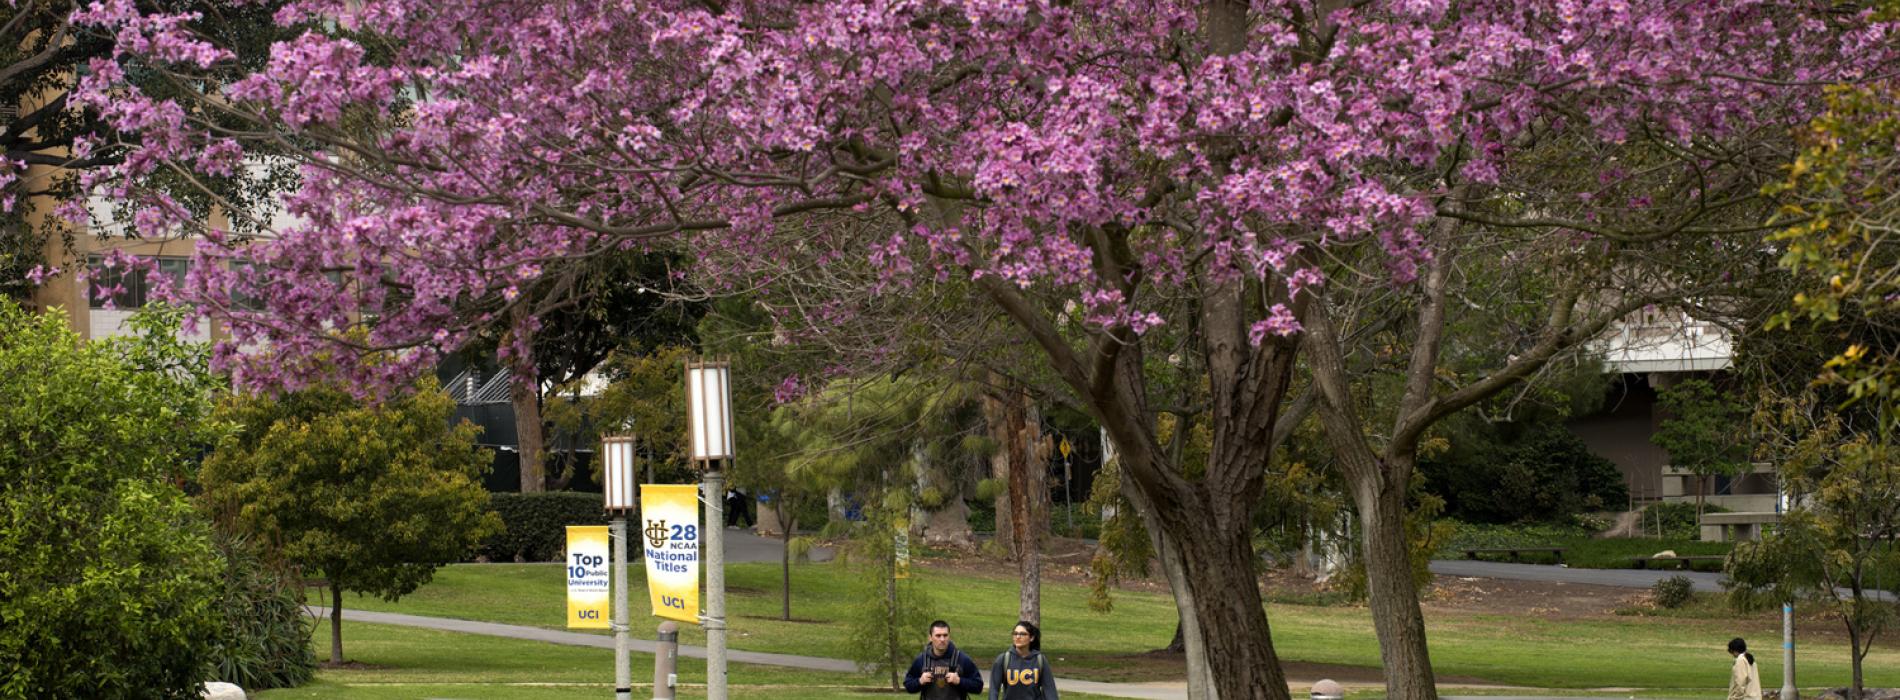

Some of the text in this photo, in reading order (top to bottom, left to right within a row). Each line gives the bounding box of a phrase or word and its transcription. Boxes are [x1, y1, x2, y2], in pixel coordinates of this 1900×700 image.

[670, 524, 697, 541] 28
[670, 542, 697, 550] NCAA
[572, 553, 603, 568] Top
[646, 548, 697, 561] National
[568, 566, 585, 578] 10
[655, 560, 688, 573] Titles
[568, 579, 608, 587] University
[662, 594, 685, 609] UCI
[578, 610, 599, 619] UCI
[1006, 668, 1039, 686] UCI
